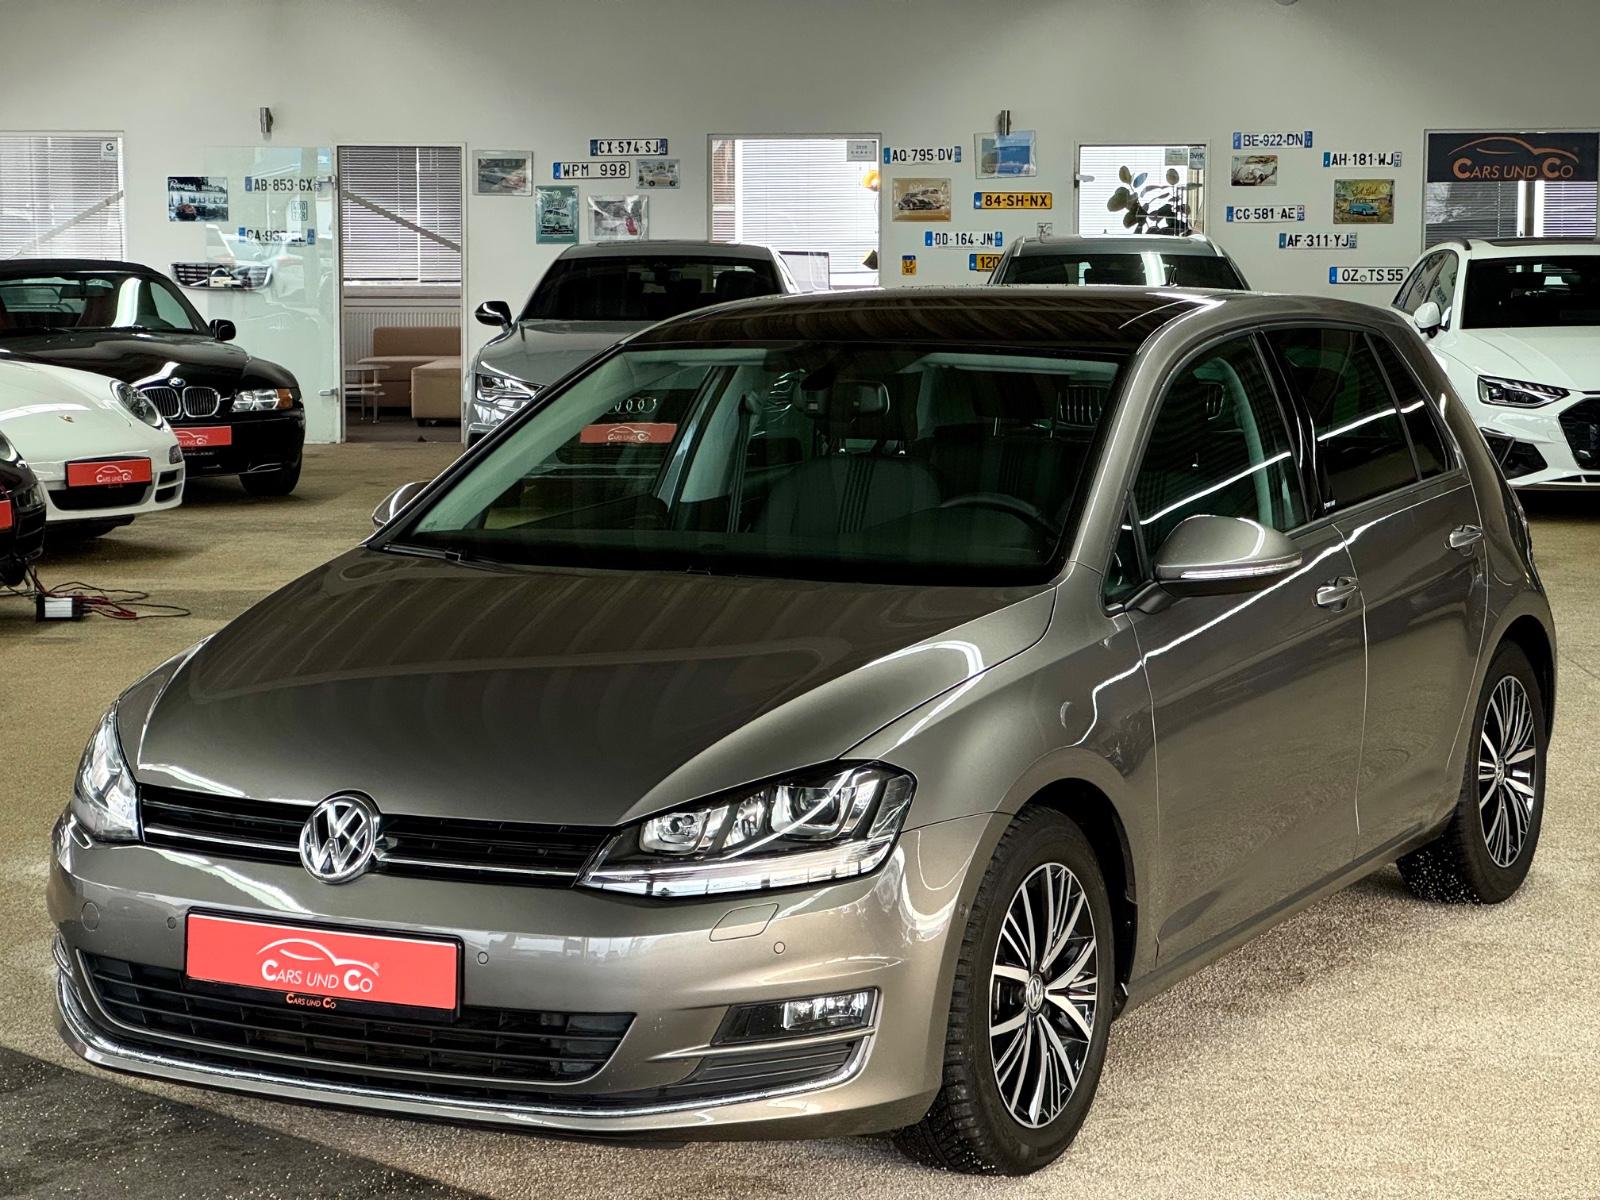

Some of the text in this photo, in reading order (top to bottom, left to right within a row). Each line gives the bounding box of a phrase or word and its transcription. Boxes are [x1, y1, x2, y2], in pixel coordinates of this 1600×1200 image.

[1243, 133, 1303, 147] BE-922-DN
[599, 141, 659, 154] CX-574-SJ
[892, 148, 953, 162] AQ-795-DV
[1331, 153, 1394, 166] AH-181-WJ
[562, 163, 627, 177] WPM 998
[1453, 157, 1574, 179] CARS UND CO
[254, 178, 313, 192] AB-853-GX
[985, 195, 1048, 207] 84-SH-NX
[1235, 207, 1296, 220] CG-581-AE
[935, 232, 993, 246] DD-164-JN
[1286, 234, 1349, 247] AF-311-YJ
[1342, 269, 1403, 282] OZ TS 55
[261, 959, 373, 993] CARS UND CO
[286, 993, 337, 1010] CARS UND CO
